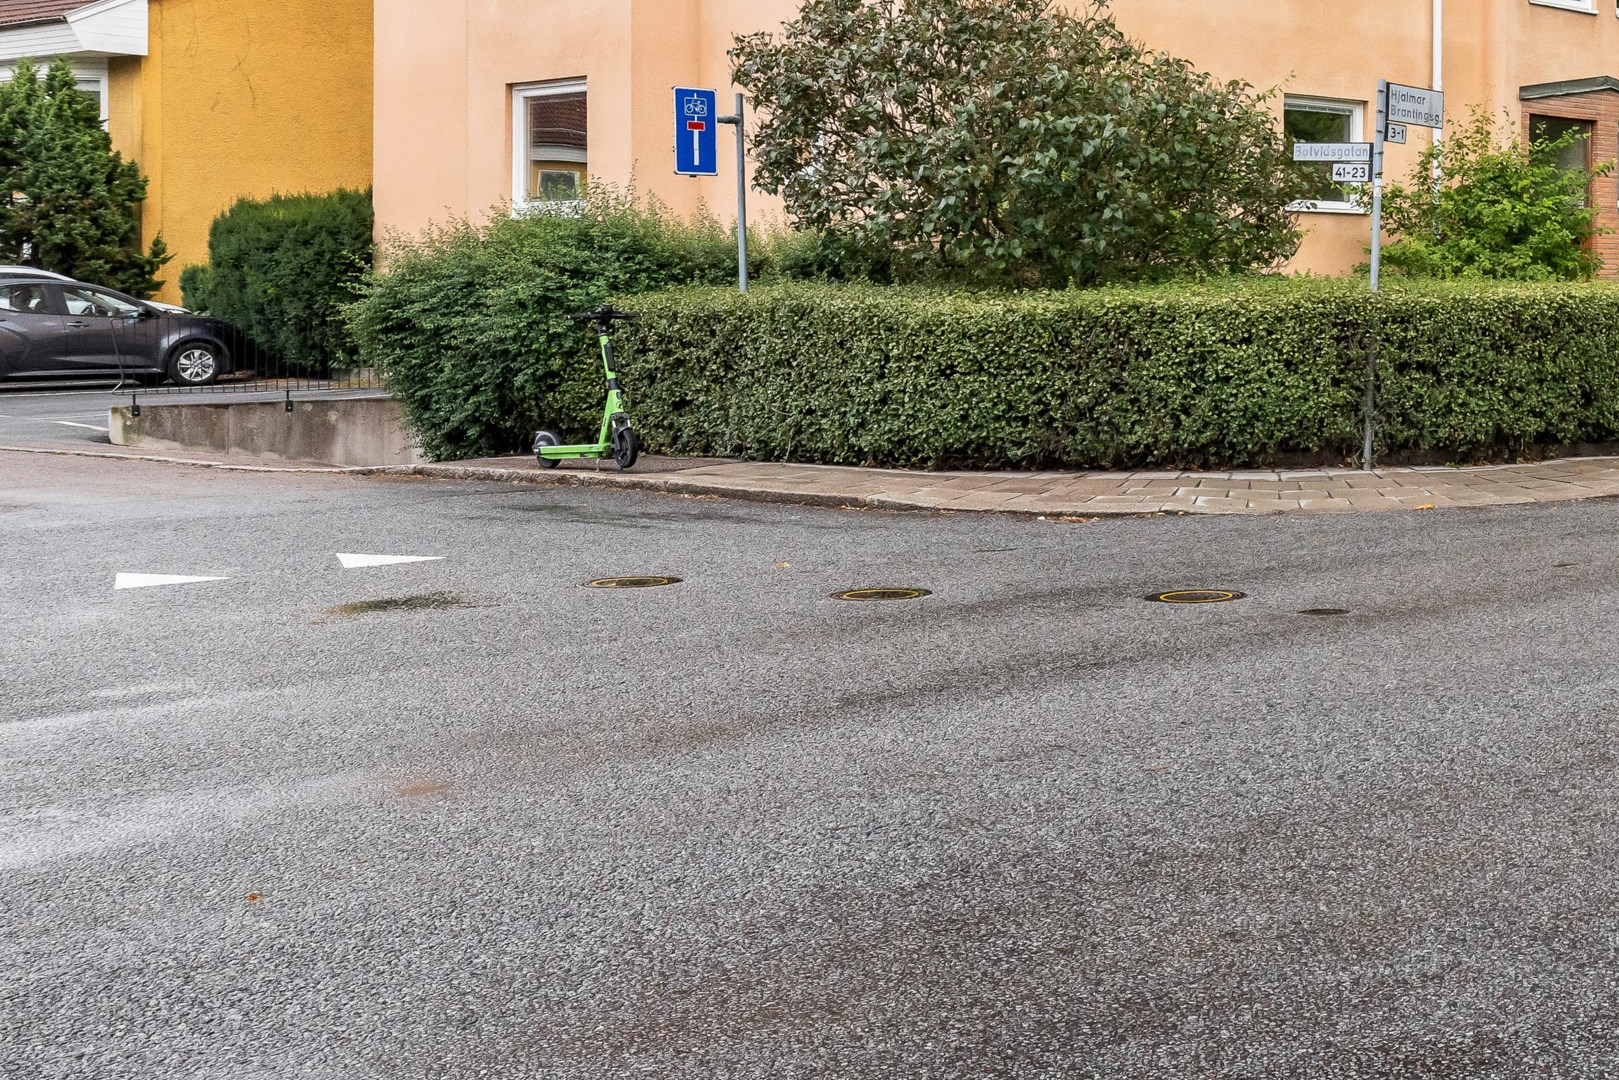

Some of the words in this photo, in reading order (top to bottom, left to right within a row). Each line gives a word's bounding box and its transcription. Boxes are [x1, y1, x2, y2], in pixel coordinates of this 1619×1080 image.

[1391, 89, 1426, 105] Hjalmar
[1390, 104, 1441, 125] Brantingsg.
[1390, 127, 1405, 140] 3-1
[1335, 166, 1366, 178] 41-23
